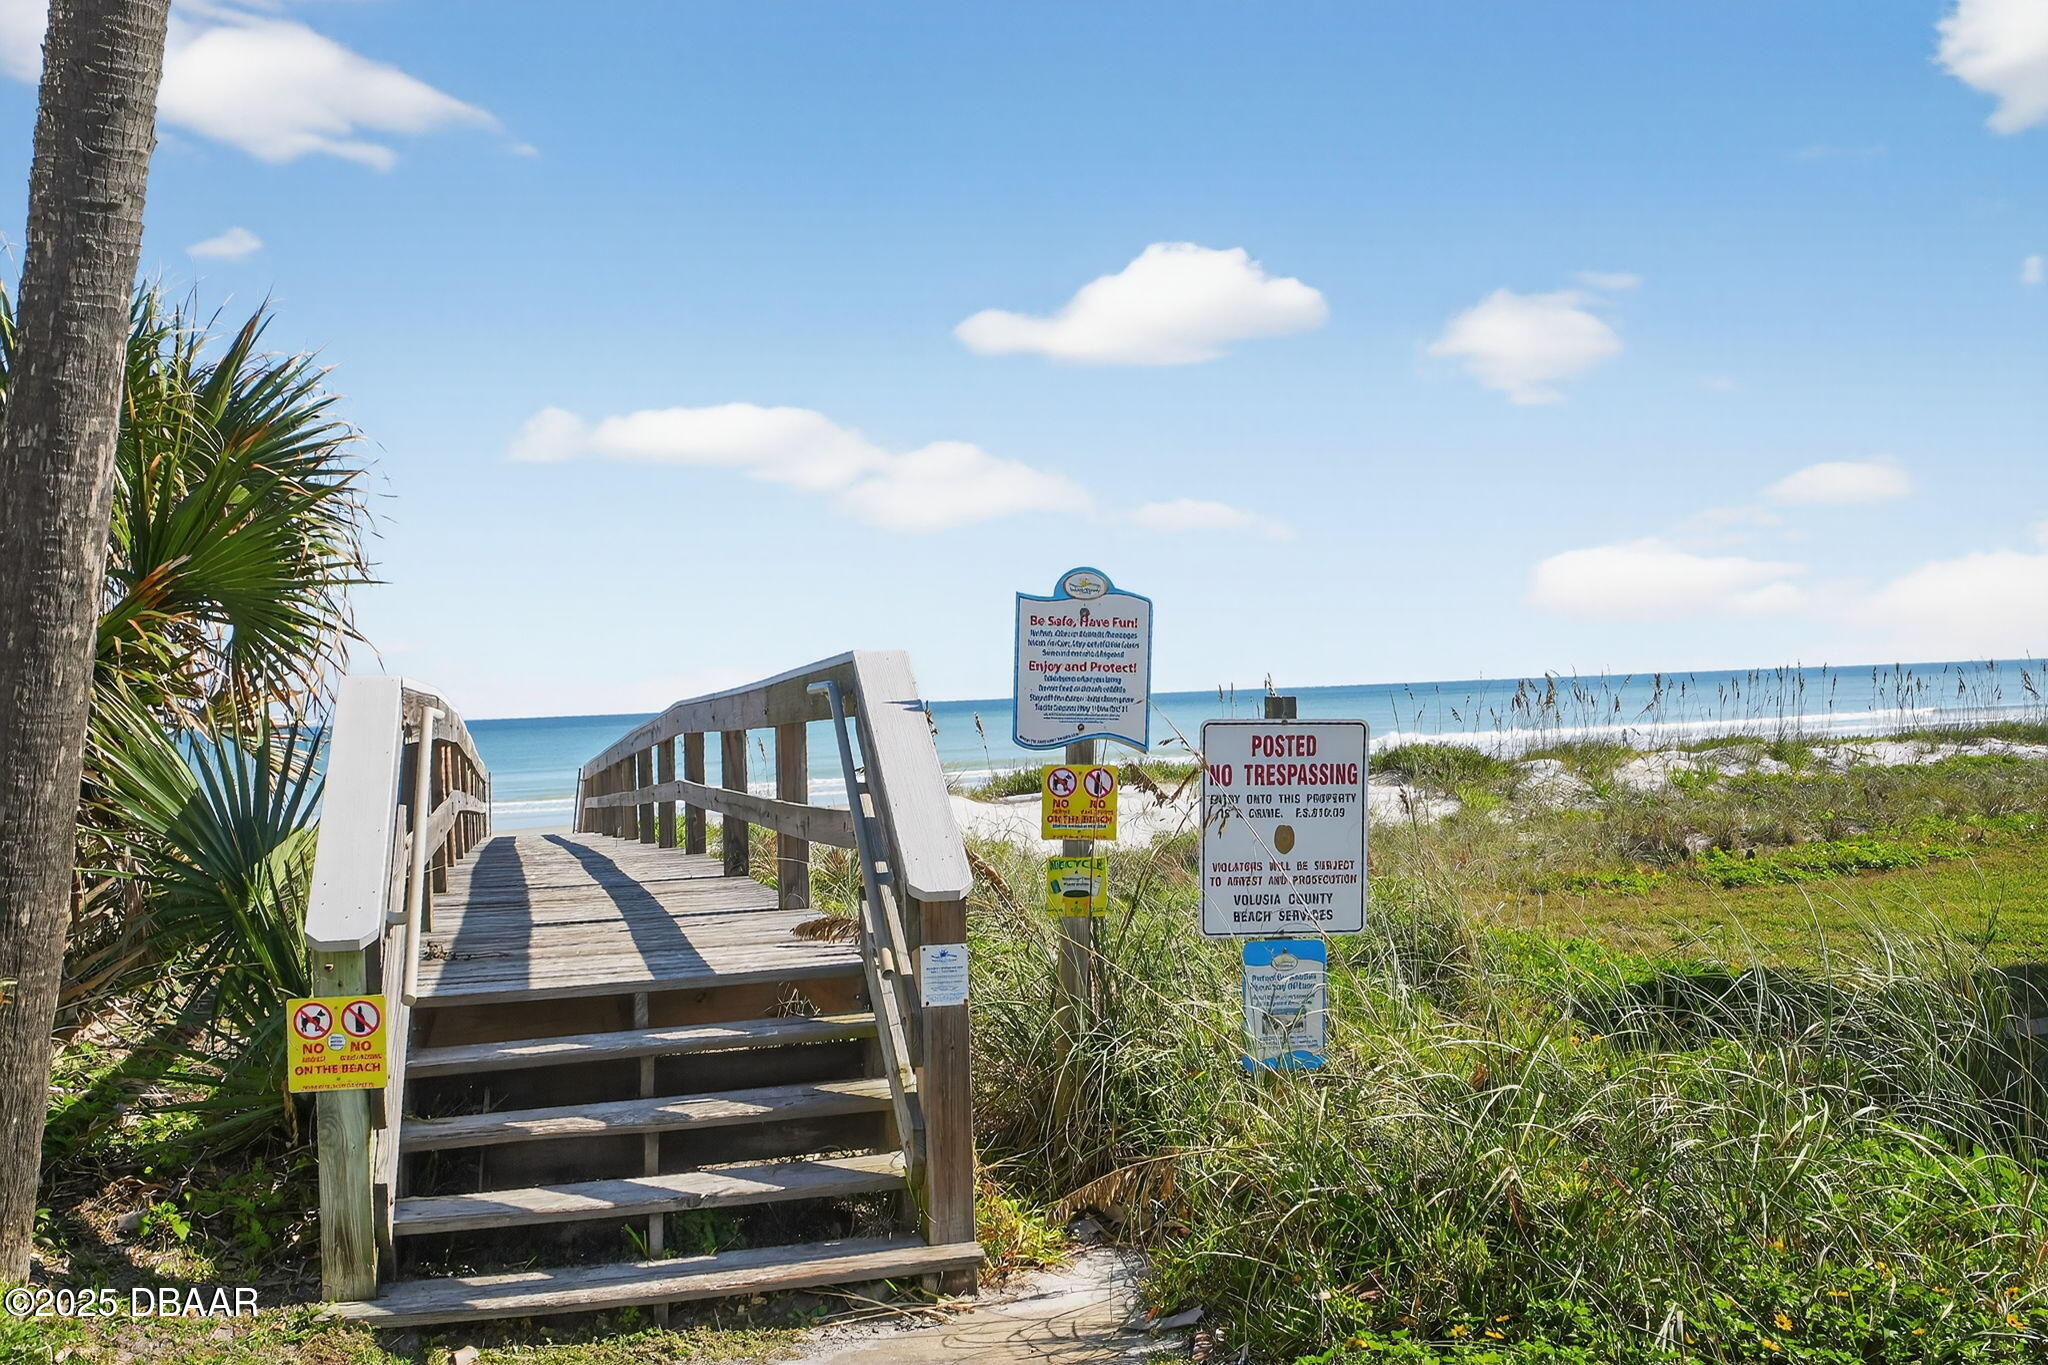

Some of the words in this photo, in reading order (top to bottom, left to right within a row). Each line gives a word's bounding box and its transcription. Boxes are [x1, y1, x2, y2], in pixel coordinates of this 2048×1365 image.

[1030, 615, 1044, 626] Be
[1048, 616, 1076, 627] Safe,
[1080, 617, 1109, 627] Have
[1113, 617, 1138, 628] Fun!
[1029, 661, 1062, 673] Enjoy
[1064, 662, 1087, 672] and
[1090, 662, 1137, 673] Protect!
[1252, 734, 1317, 757] POSTED
[1209, 764, 1233, 787] NO
[1244, 763, 1358, 786] TRESPASSING
[1053, 799, 1069, 808] NO
[1090, 800, 1105, 808] NO
[1247, 795, 1272, 804] ONTO
[1279, 794, 1300, 804] THIS
[1307, 794, 1356, 804] PROPERTY
[1212, 862, 1263, 872] VIOLATORS
[1269, 862, 1290, 871] WILL
[1297, 861, 1308, 870] BE
[1314, 860, 1354, 870] SUBJECT
[1210, 877, 1221, 886] TO
[1227, 876, 1262, 886] ARREST
[1269, 876, 1288, 885] AND
[1293, 874, 1357, 884] PROSECUTION
[1234, 894, 1280, 905] VOLUSIA
[1289, 893, 1333, 904] COUNTY
[1234, 911, 1271, 922] BEACH
[1279, 910, 1333, 921] SERVICES
[303, 1043, 324, 1054] NO
[351, 1041, 371, 1051] NO
[295, 1066, 312, 1075] ON
[315, 1065, 338, 1073] THE
[342, 1063, 380, 1073] BEACH
